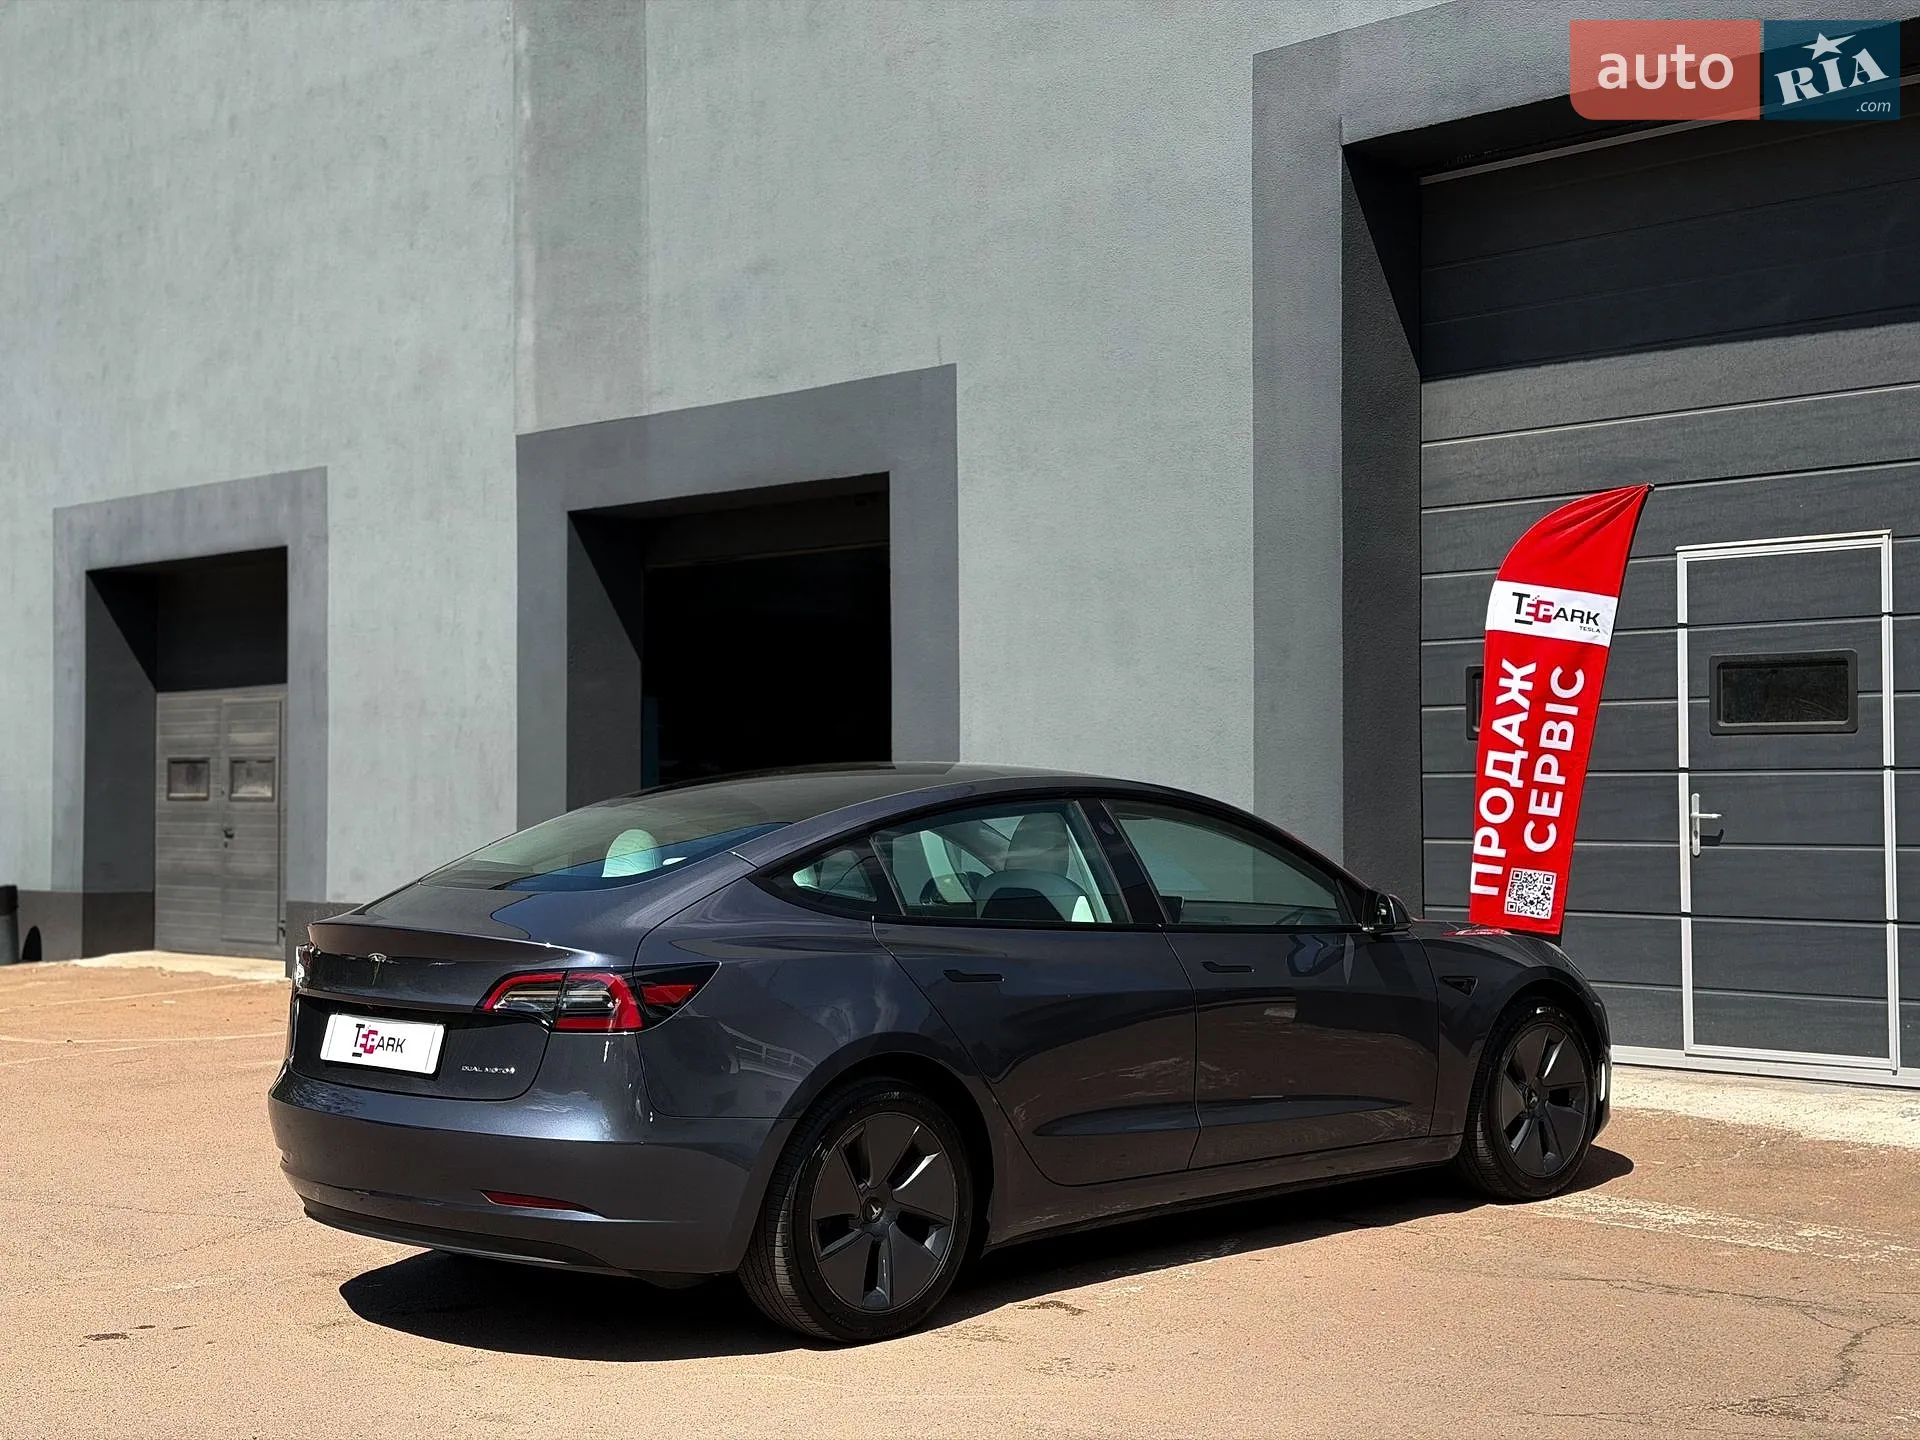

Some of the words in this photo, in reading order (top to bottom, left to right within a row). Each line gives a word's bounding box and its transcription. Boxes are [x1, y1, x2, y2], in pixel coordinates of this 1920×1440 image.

[1579, 625, 1601, 634] TESLA
[1470, 659, 1537, 896] ПРОДАЖ
[1523, 665, 1585, 852] СЕРВІС
[461, 1065, 483, 1073] DUAL
